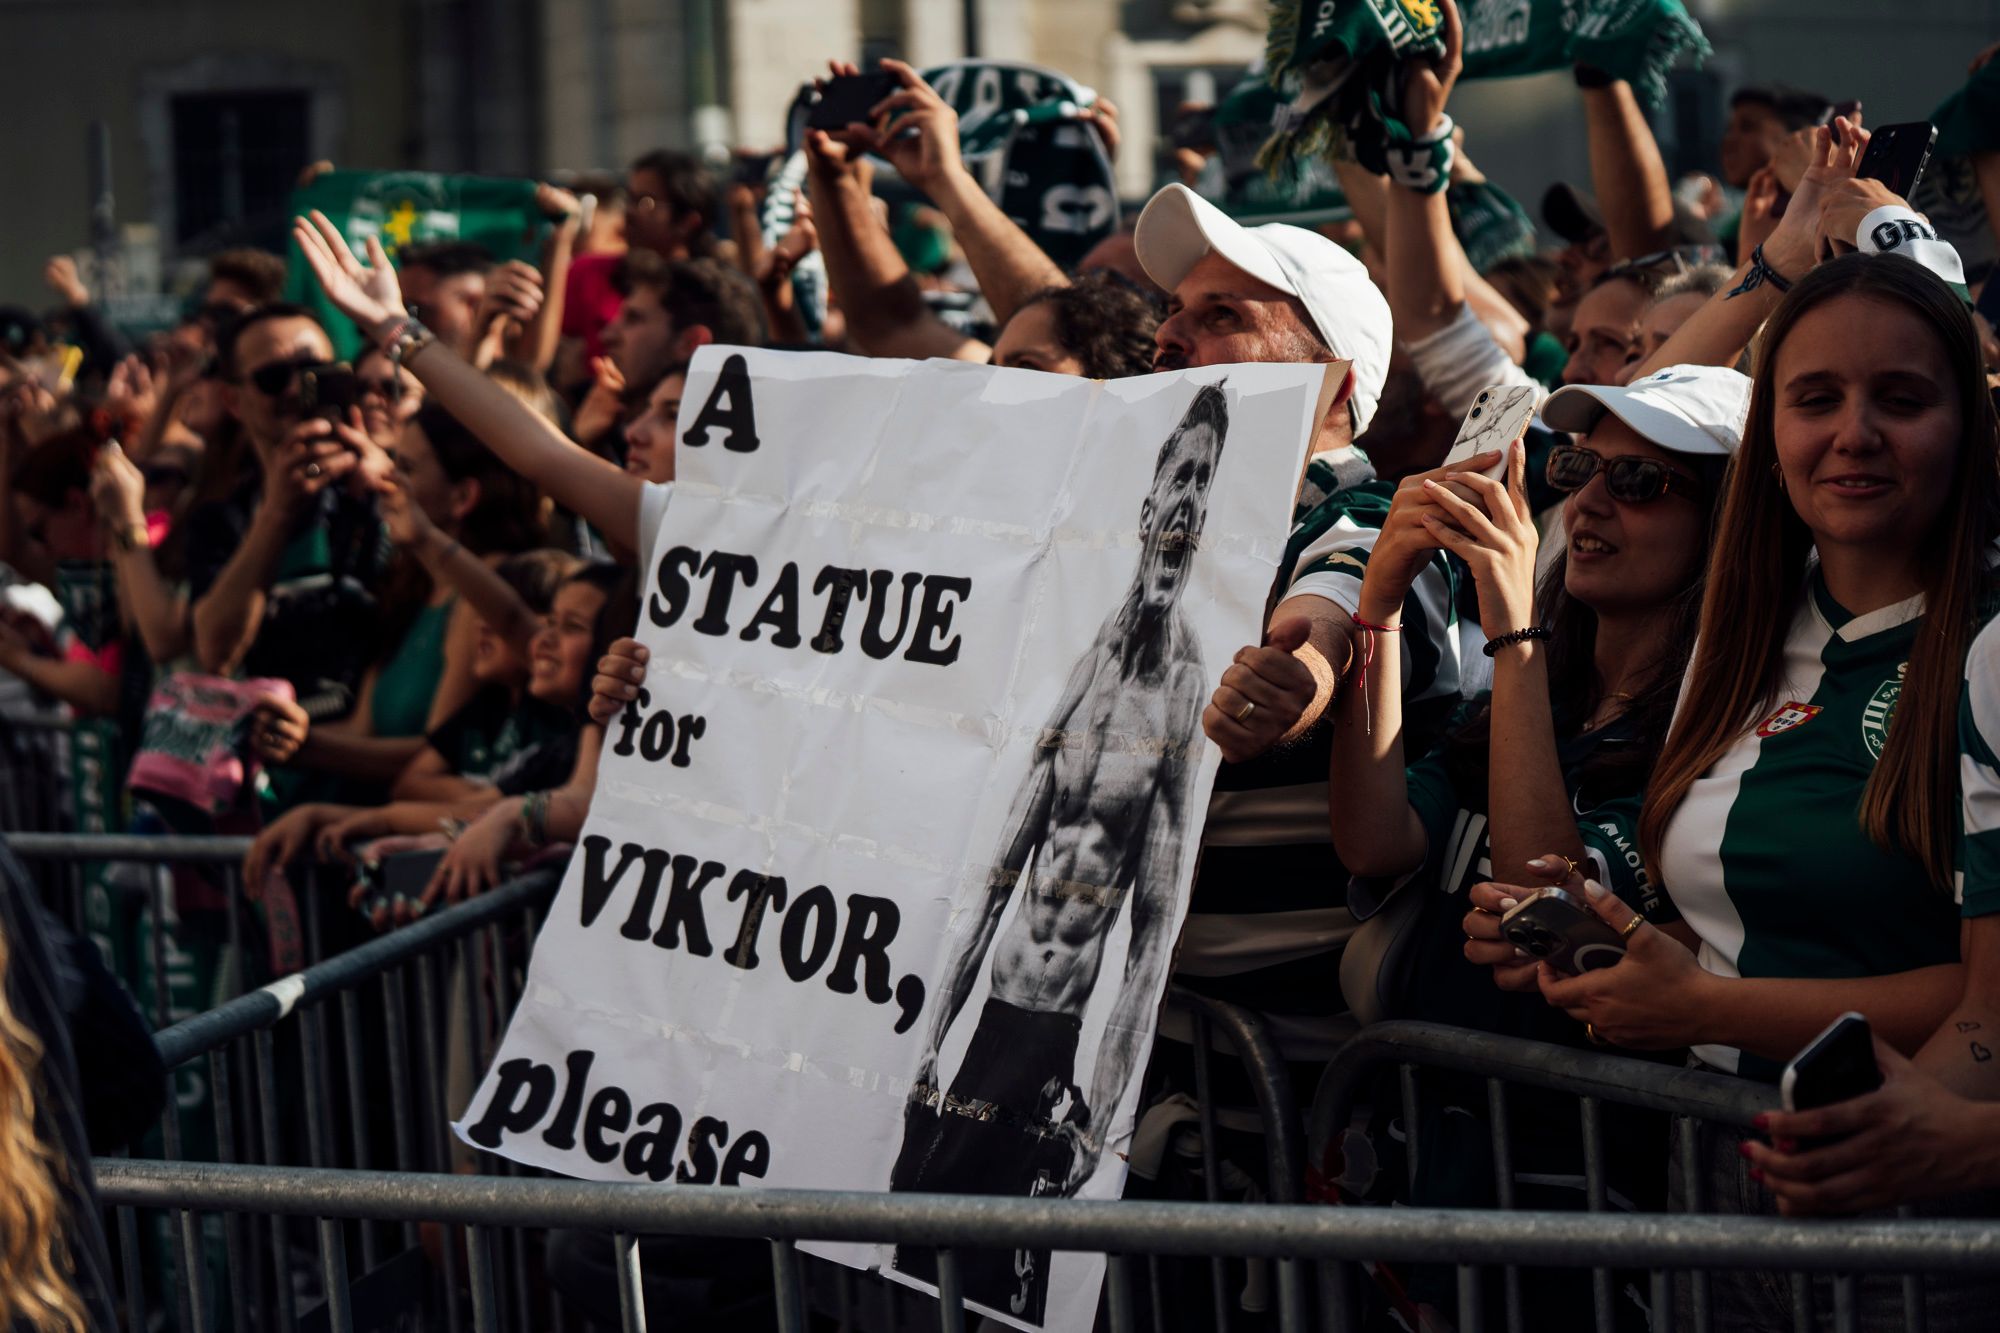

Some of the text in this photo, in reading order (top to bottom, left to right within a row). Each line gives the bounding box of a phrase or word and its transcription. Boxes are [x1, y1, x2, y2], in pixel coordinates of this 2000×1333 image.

[682, 354, 761, 454] A
[649, 545, 972, 667] STATUE
[613, 687, 707, 768] for
[1613, 836, 1660, 912] MOCHE
[580, 834, 926, 1035] VIKTOR,
[467, 1049, 771, 1187] please
